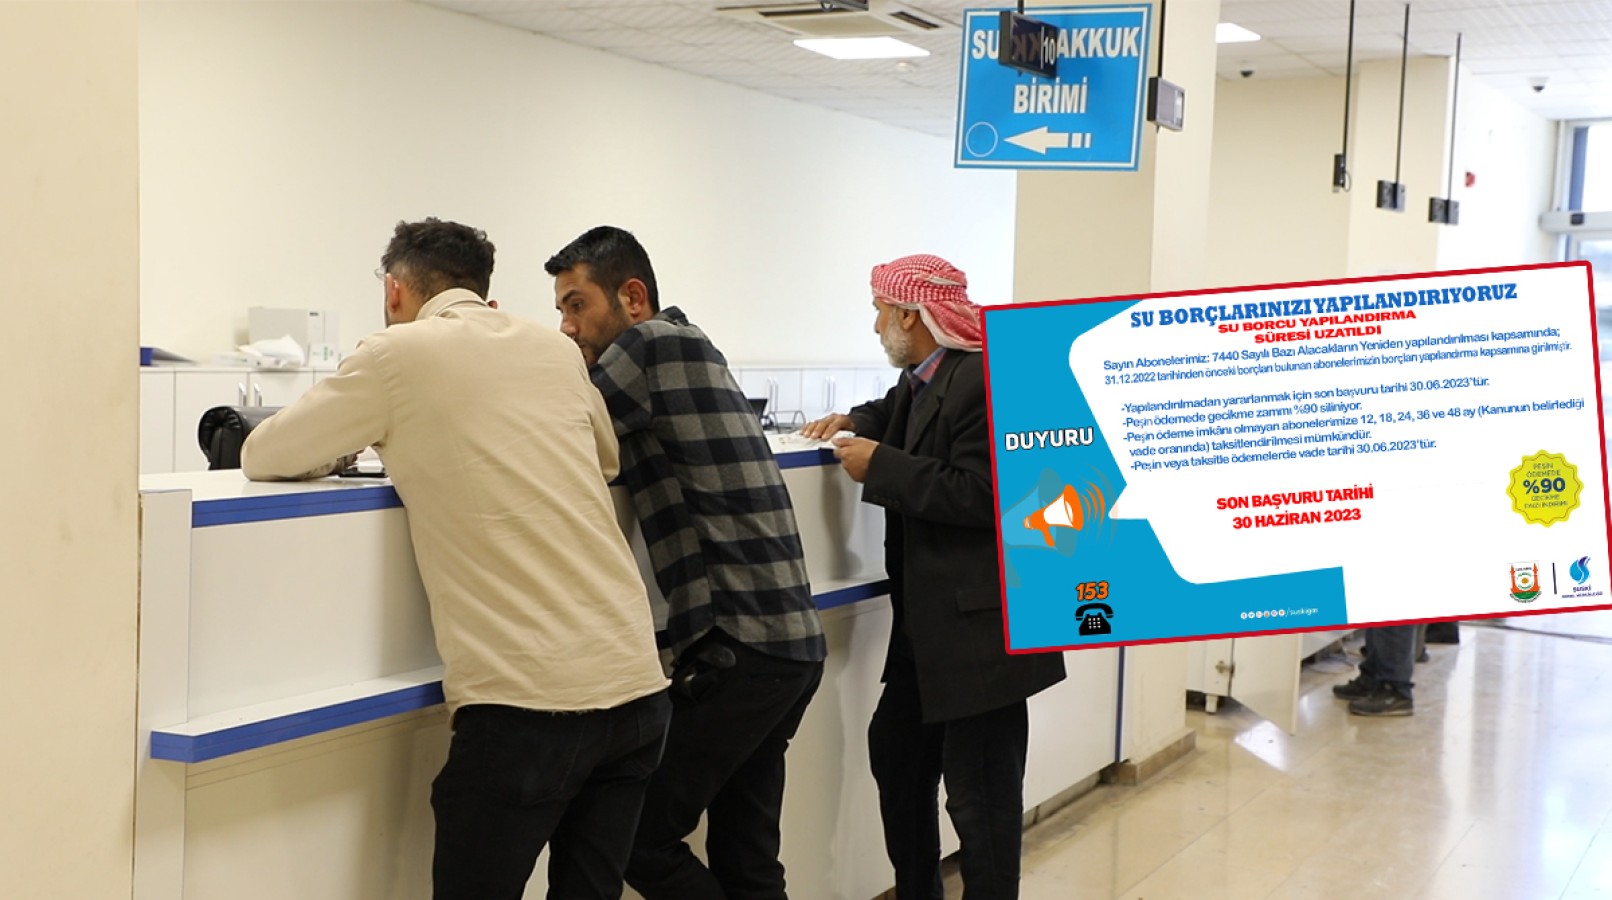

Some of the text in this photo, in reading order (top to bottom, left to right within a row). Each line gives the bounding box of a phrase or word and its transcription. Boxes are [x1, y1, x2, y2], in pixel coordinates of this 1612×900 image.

[972, 29, 998, 59] SU
[1056, 27, 1140, 58] AKKUK
[1014, 77, 1088, 114] BİRİMİ
